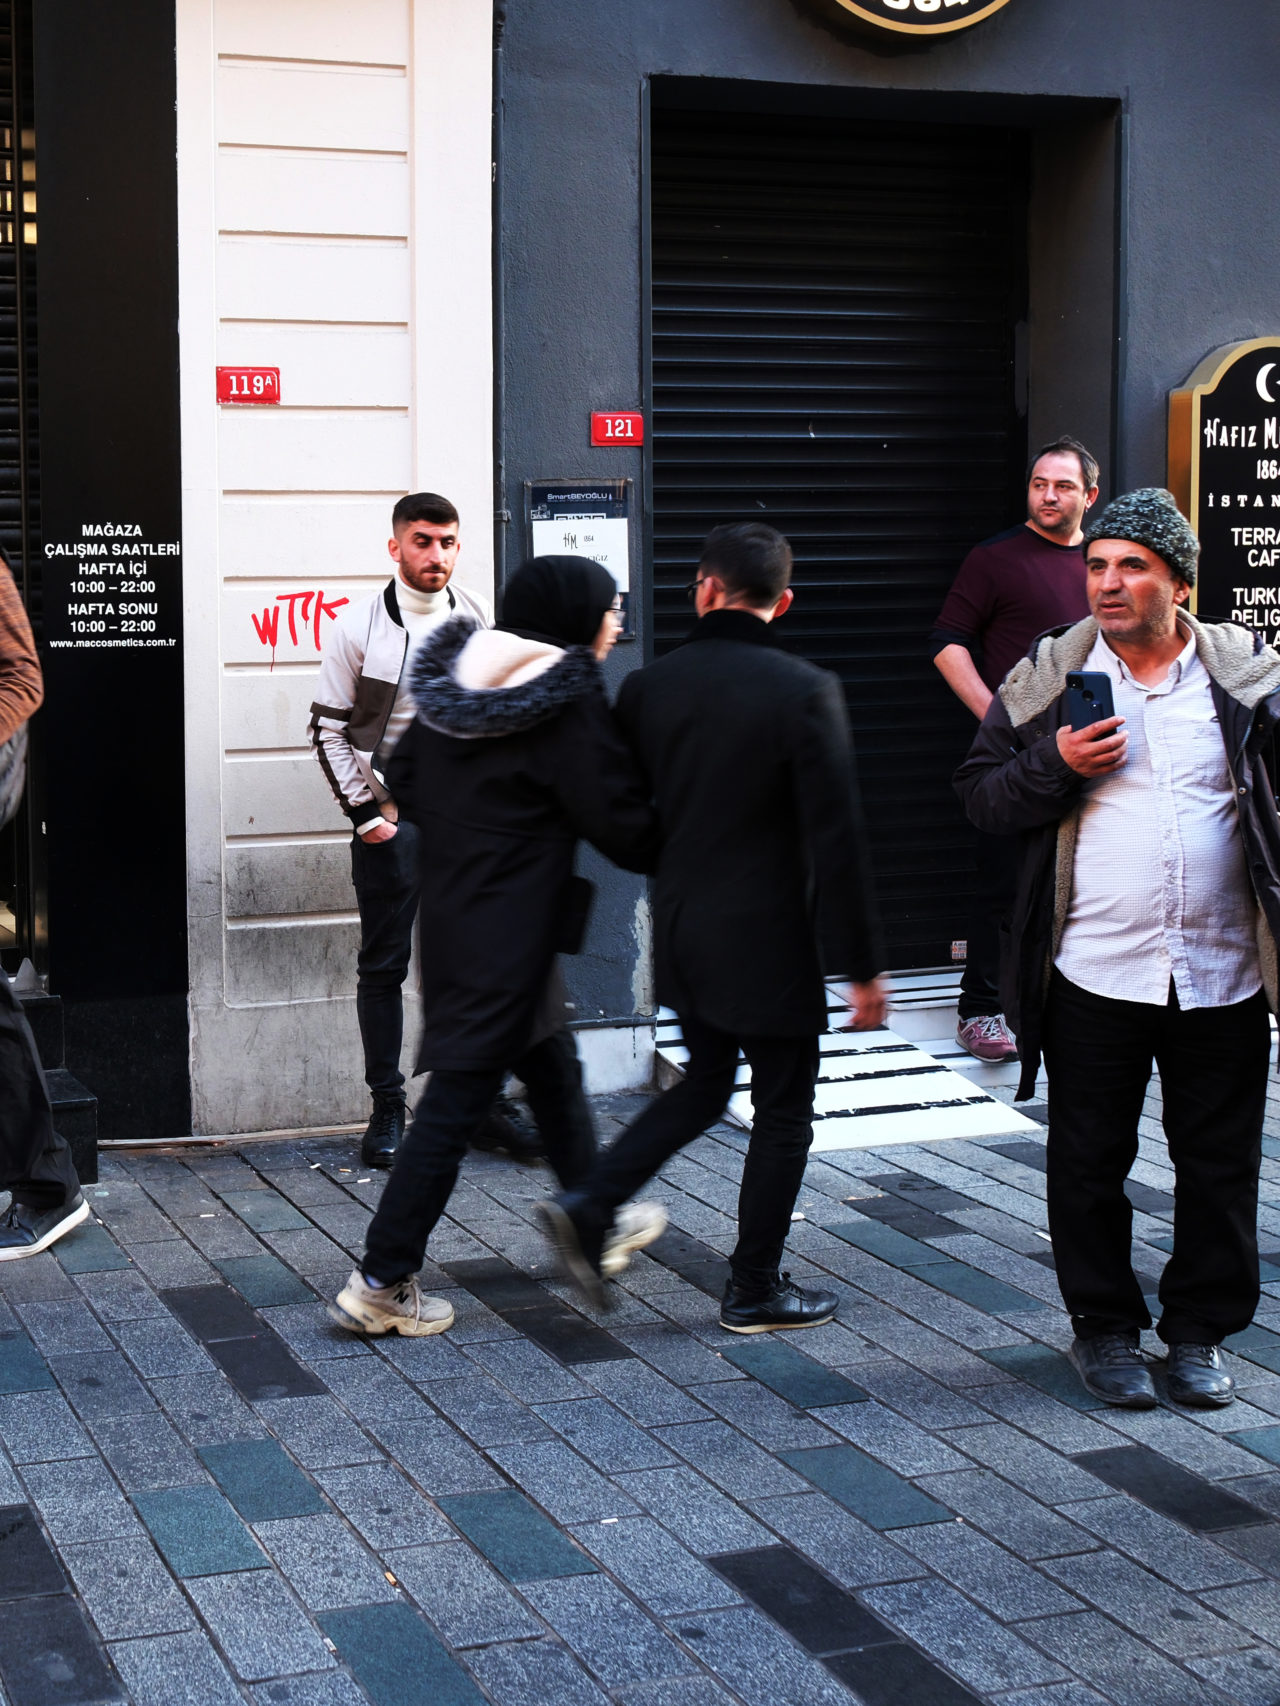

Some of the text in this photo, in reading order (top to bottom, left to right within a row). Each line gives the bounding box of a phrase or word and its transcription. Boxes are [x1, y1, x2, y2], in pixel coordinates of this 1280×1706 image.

[229, 375, 272, 395] 119A
[605, 419, 634, 437] 121
[1264, 416, 1280, 450] M
[1256, 459, 1280, 480] 186
[82, 522, 142, 536] MAĞAZA
[44, 541, 180, 558] ÇALIŞMA SAATLERİ
[78, 560, 147, 577] HAFTA İÇİ
[70, 581, 105, 593] 10:00
[120, 581, 156, 593] 22:00
[68, 603, 158, 615] HAFTA SONU
[70, 621, 105, 633] 10:00
[120, 620, 156, 632] 22:00
[49, 638, 177, 648] www.maccosmetics.com.tr
